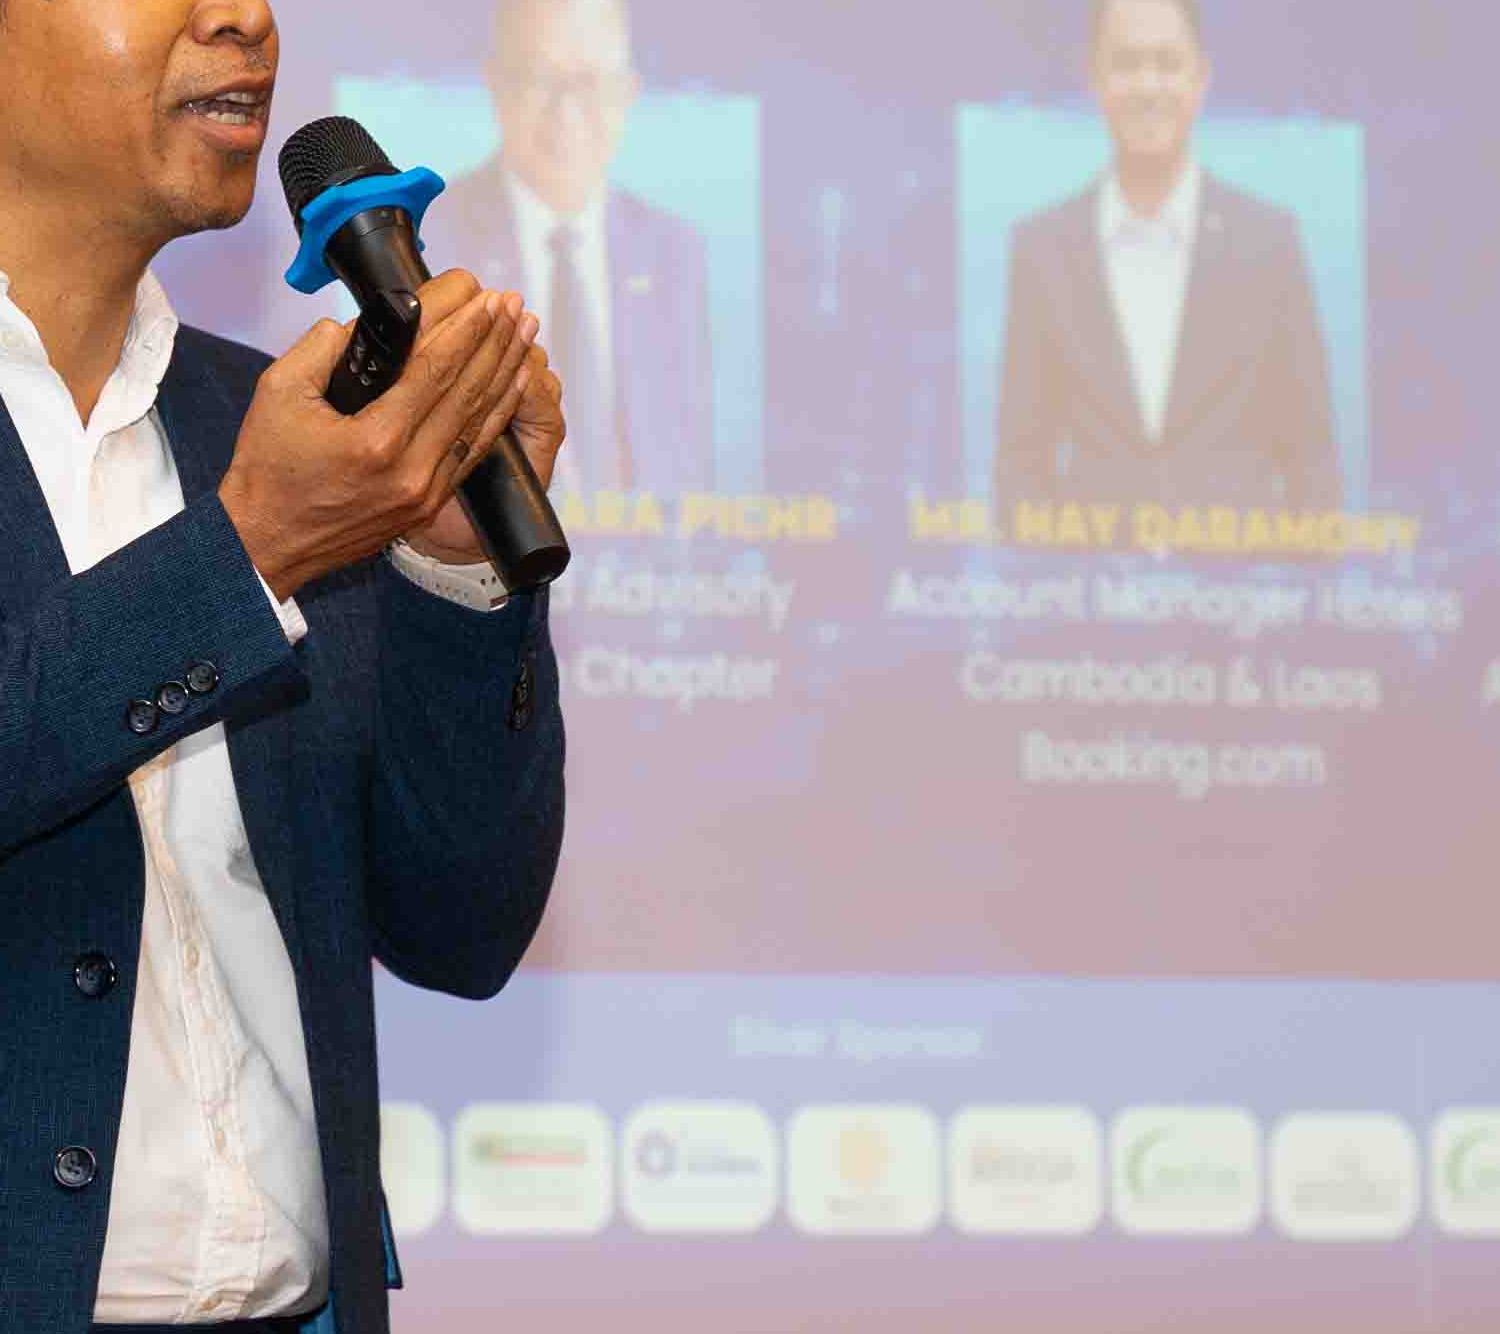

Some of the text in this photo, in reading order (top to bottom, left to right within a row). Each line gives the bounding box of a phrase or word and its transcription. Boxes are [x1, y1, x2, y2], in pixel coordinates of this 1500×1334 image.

[888, 569, 1086, 619] Account
[1099, 573, 1307, 637] Manager
[573, 647, 777, 712] Chapter
[962, 651, 1216, 706] Cambodia
[1275, 659, 1381, 710] Laos
[1021, 730, 1327, 800] Booking.com
